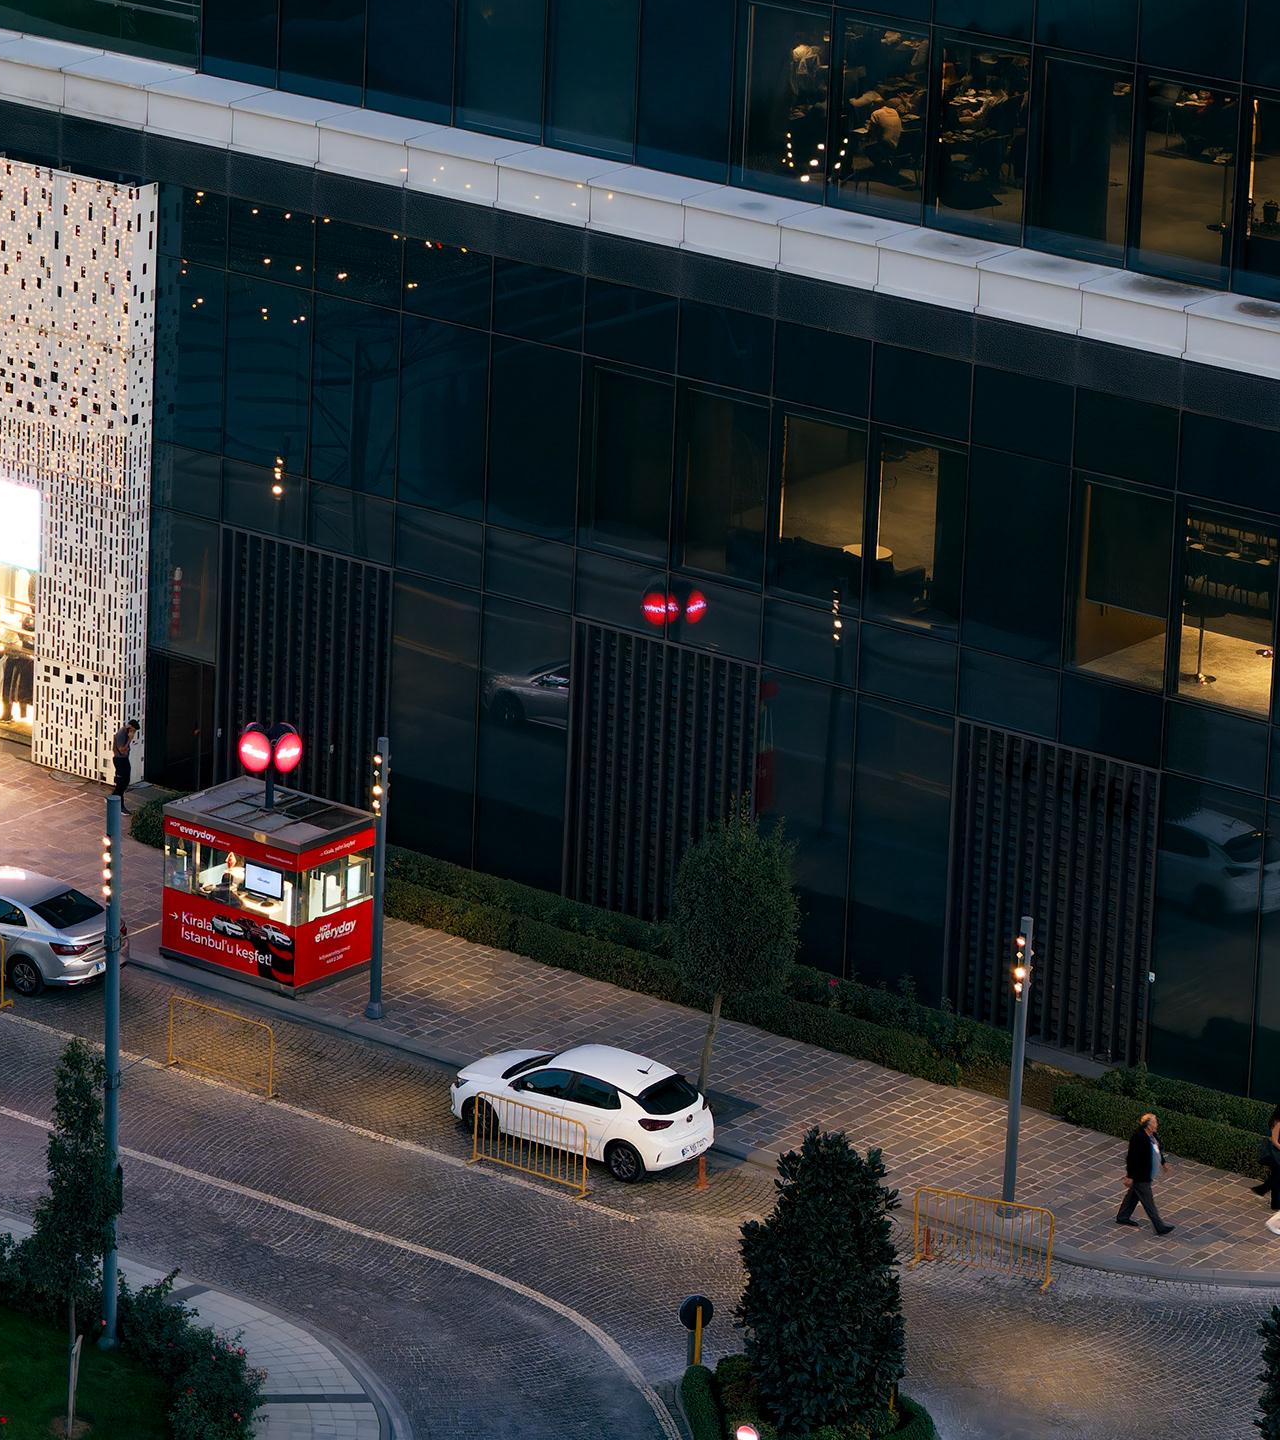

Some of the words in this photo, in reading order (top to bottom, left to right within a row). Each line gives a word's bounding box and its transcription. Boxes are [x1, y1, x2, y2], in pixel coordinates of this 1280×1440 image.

[179, 824, 216, 843] everyday
[181, 911, 216, 935] Kirala,
[314, 919, 357, 943] everyday
[181, 923, 234, 955] İstanbul'u
[235, 944, 273, 967] keşfet!
